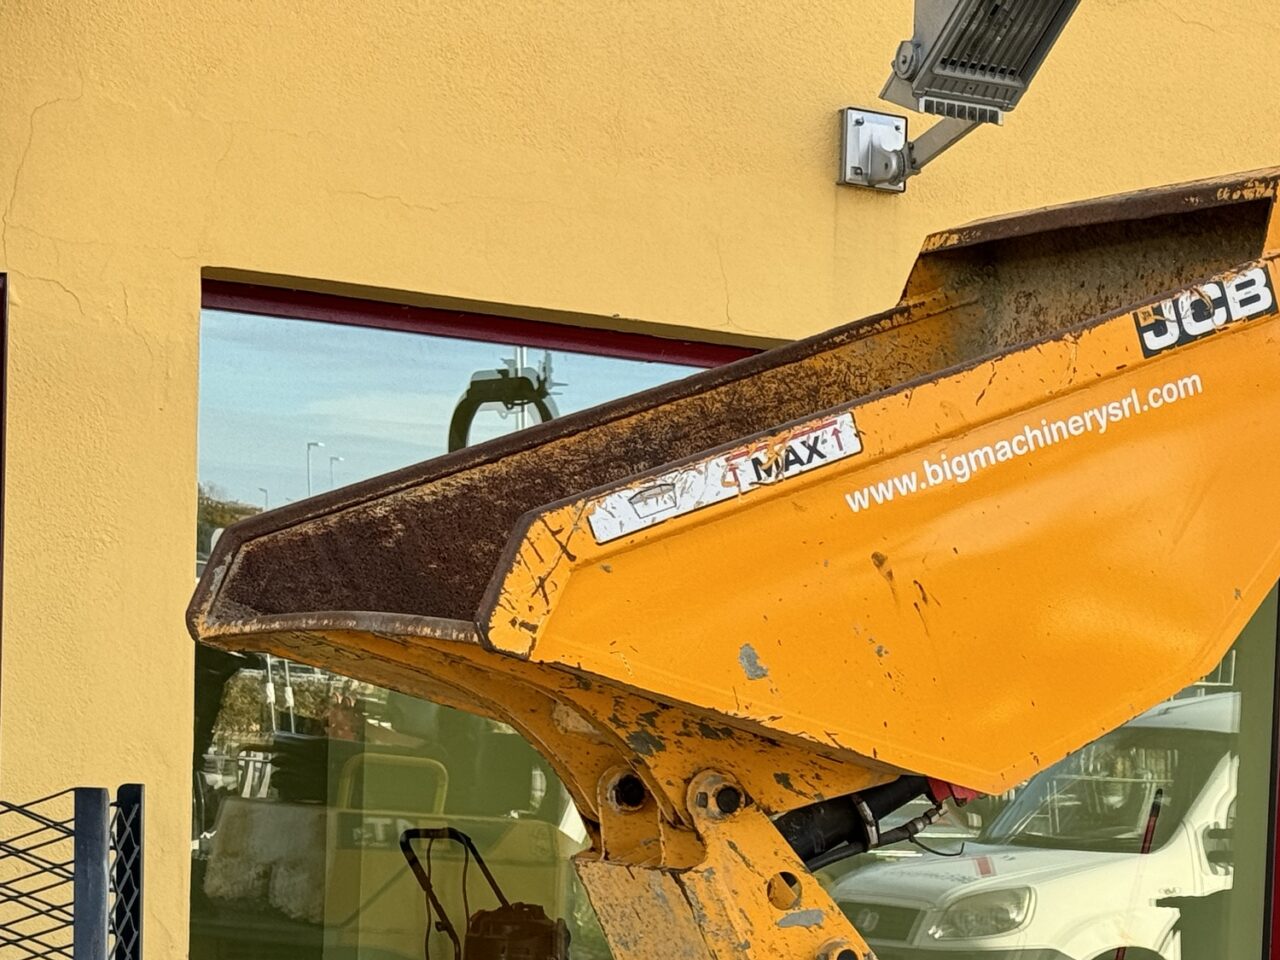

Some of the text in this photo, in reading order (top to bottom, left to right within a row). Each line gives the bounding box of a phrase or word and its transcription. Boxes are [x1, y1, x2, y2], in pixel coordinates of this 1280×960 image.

[1142, 267, 1273, 351] JCB
[751, 435, 827, 482] MAX
[844, 374, 1203, 513] www.bigmachinerysrl.com
